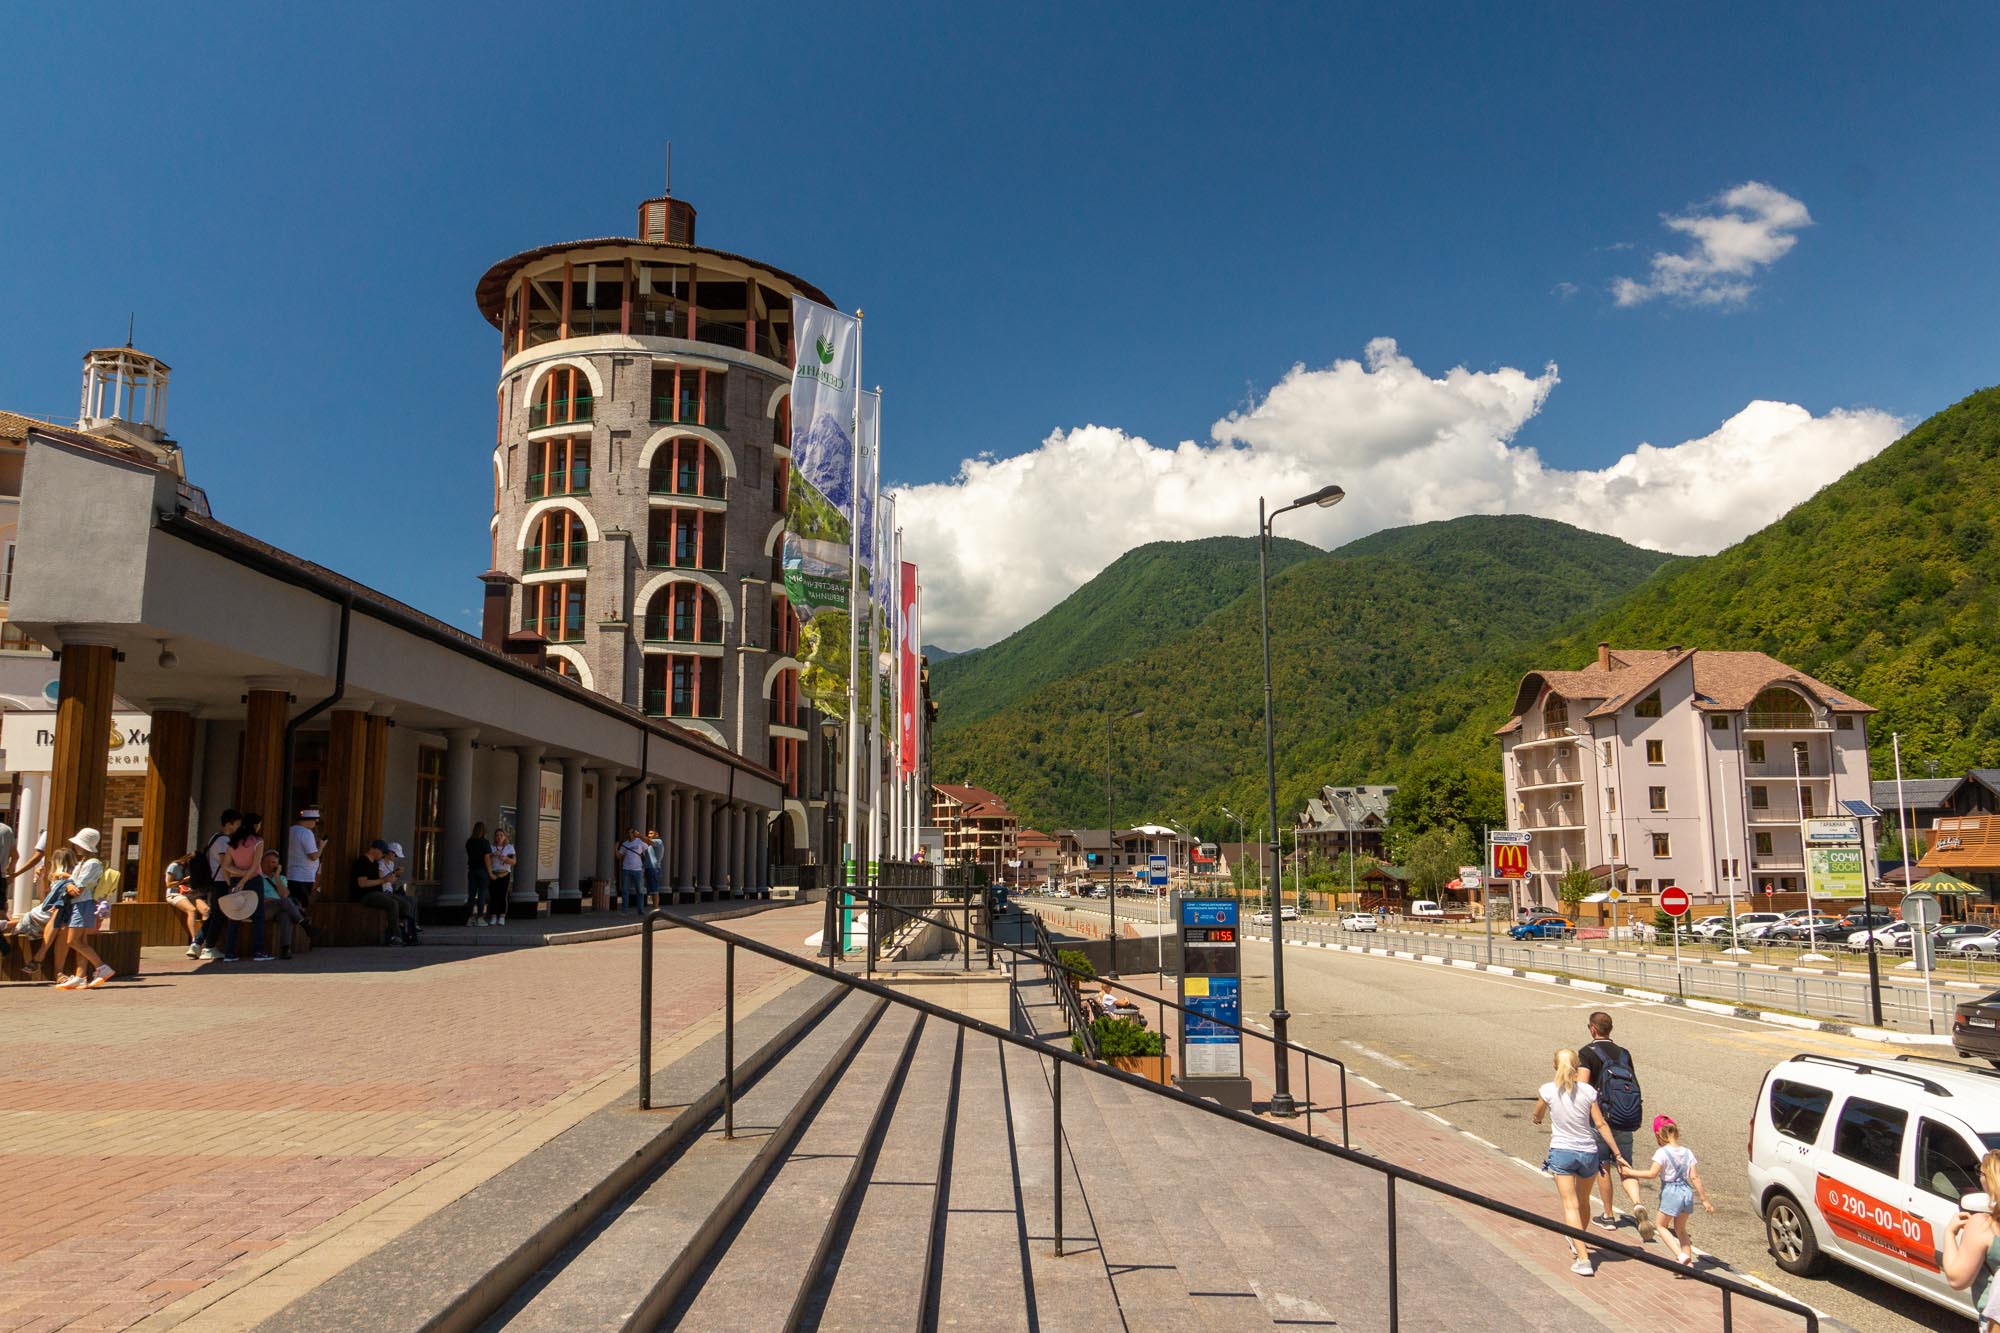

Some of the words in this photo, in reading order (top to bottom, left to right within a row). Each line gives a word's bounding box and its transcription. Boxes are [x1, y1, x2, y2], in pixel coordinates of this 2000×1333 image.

[1830, 853, 1859, 862] СОЧИ
[1831, 862, 1860, 871] SOCHI
[1842, 1193, 1920, 1241] 290-00-00
